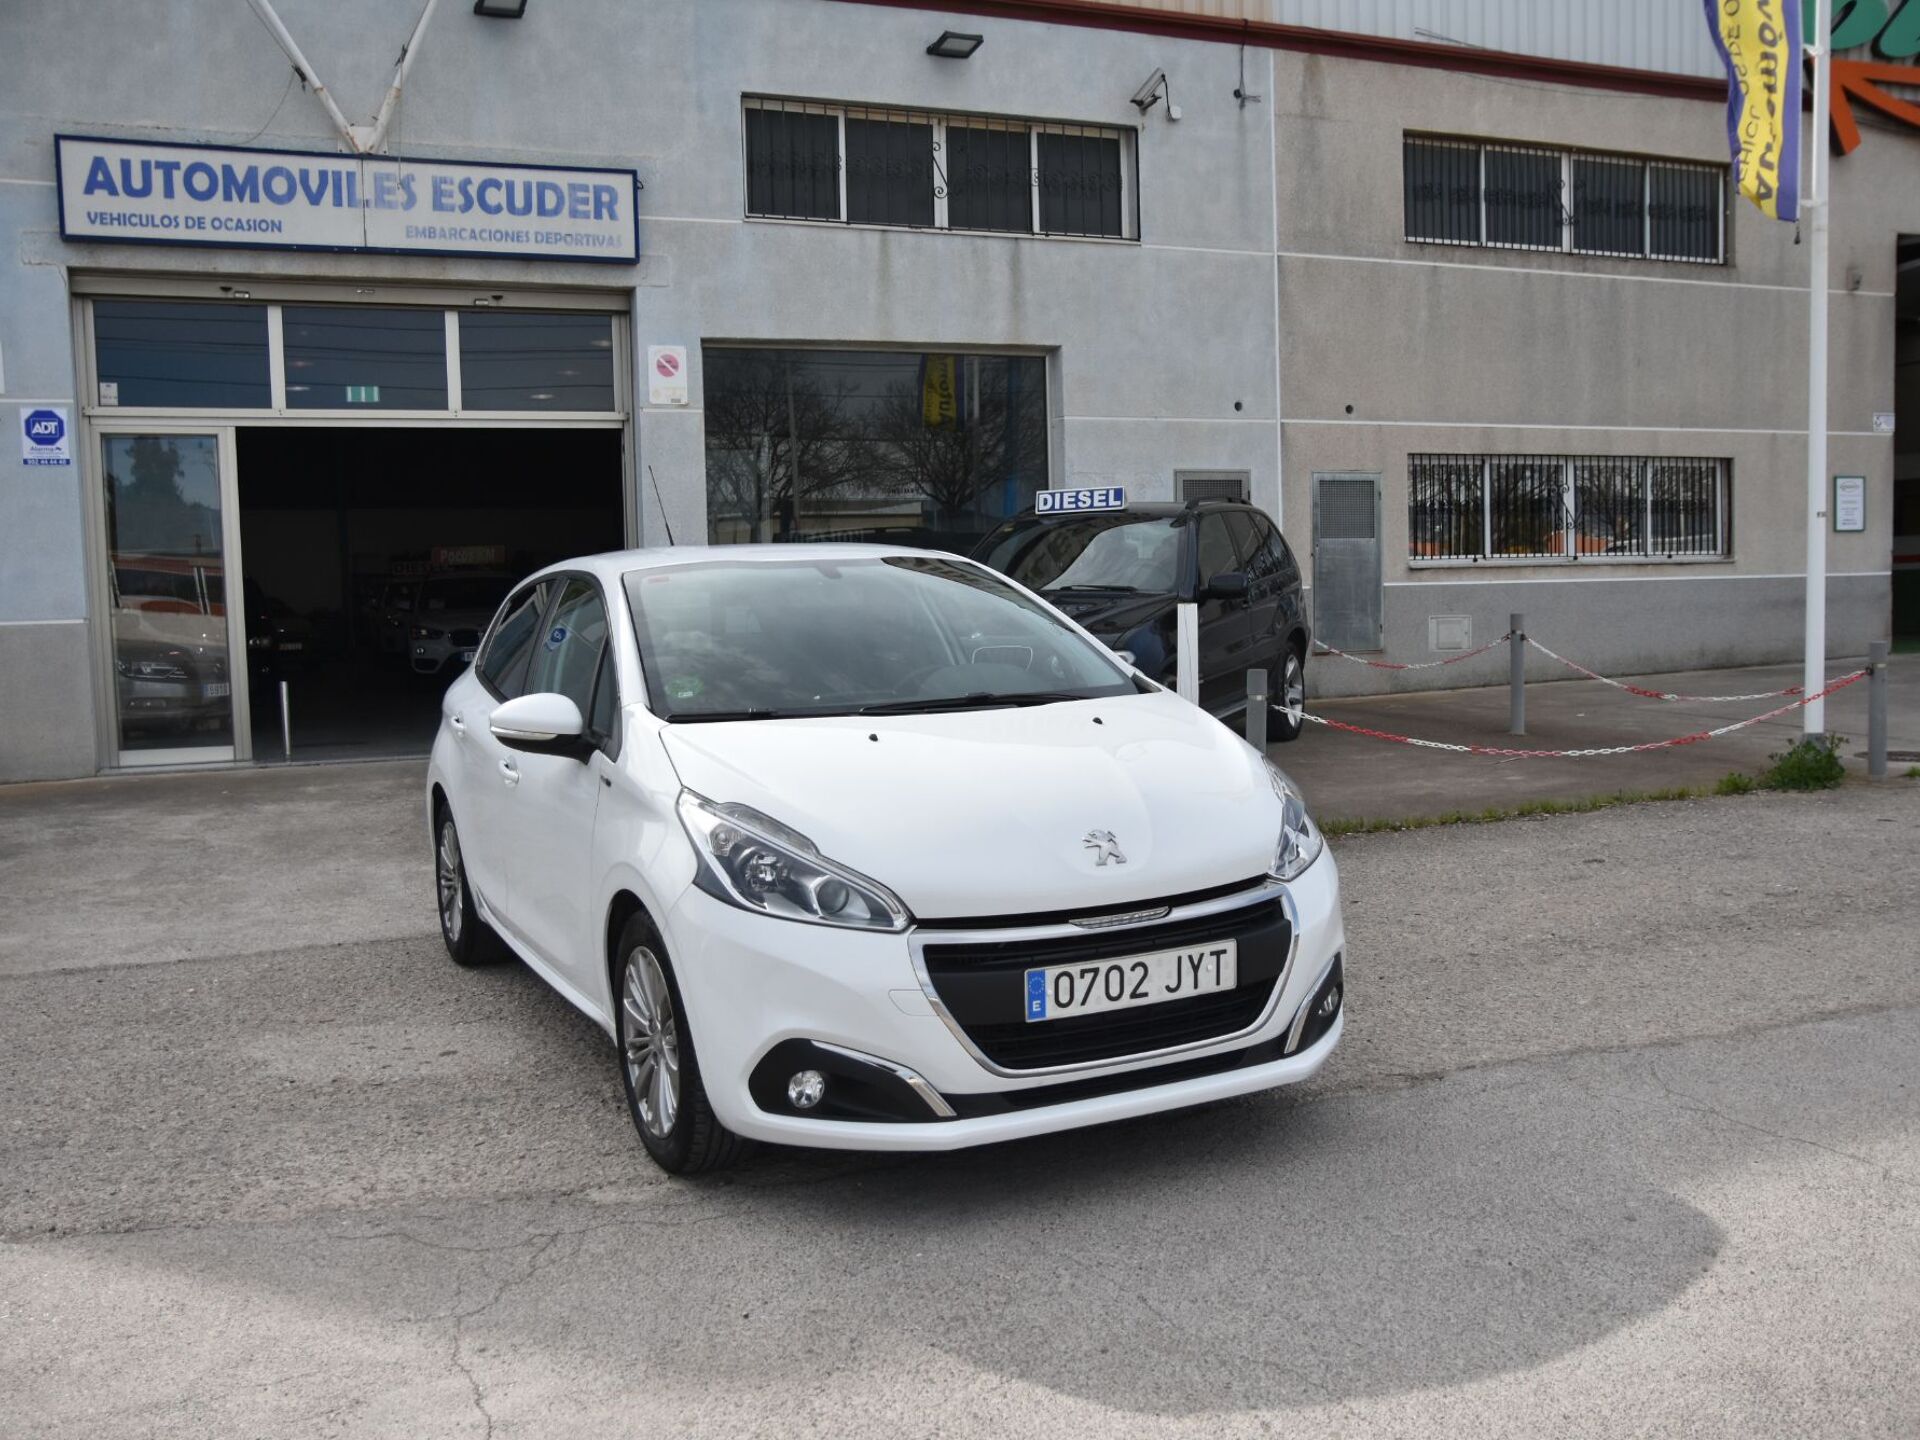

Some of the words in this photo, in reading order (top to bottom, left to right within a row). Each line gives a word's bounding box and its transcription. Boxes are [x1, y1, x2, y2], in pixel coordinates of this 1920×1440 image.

[83, 156, 418, 211] AUTOMOVILES
[431, 172, 620, 221] ESCUDER
[87, 211, 180, 230] VEHICULOS
[185, 216, 206, 230] DE
[211, 217, 283, 233] OCASION
[405, 225, 530, 244] EMBARCACIONES
[534, 230, 622, 248] DEPORTIVAS
[32, 421, 58, 434] ADT
[1038, 489, 1122, 511] DIESEL
[1054, 961, 1149, 1009] 0702
[1165, 949, 1228, 993] JYT
[1032, 1000, 1042, 1012] E
